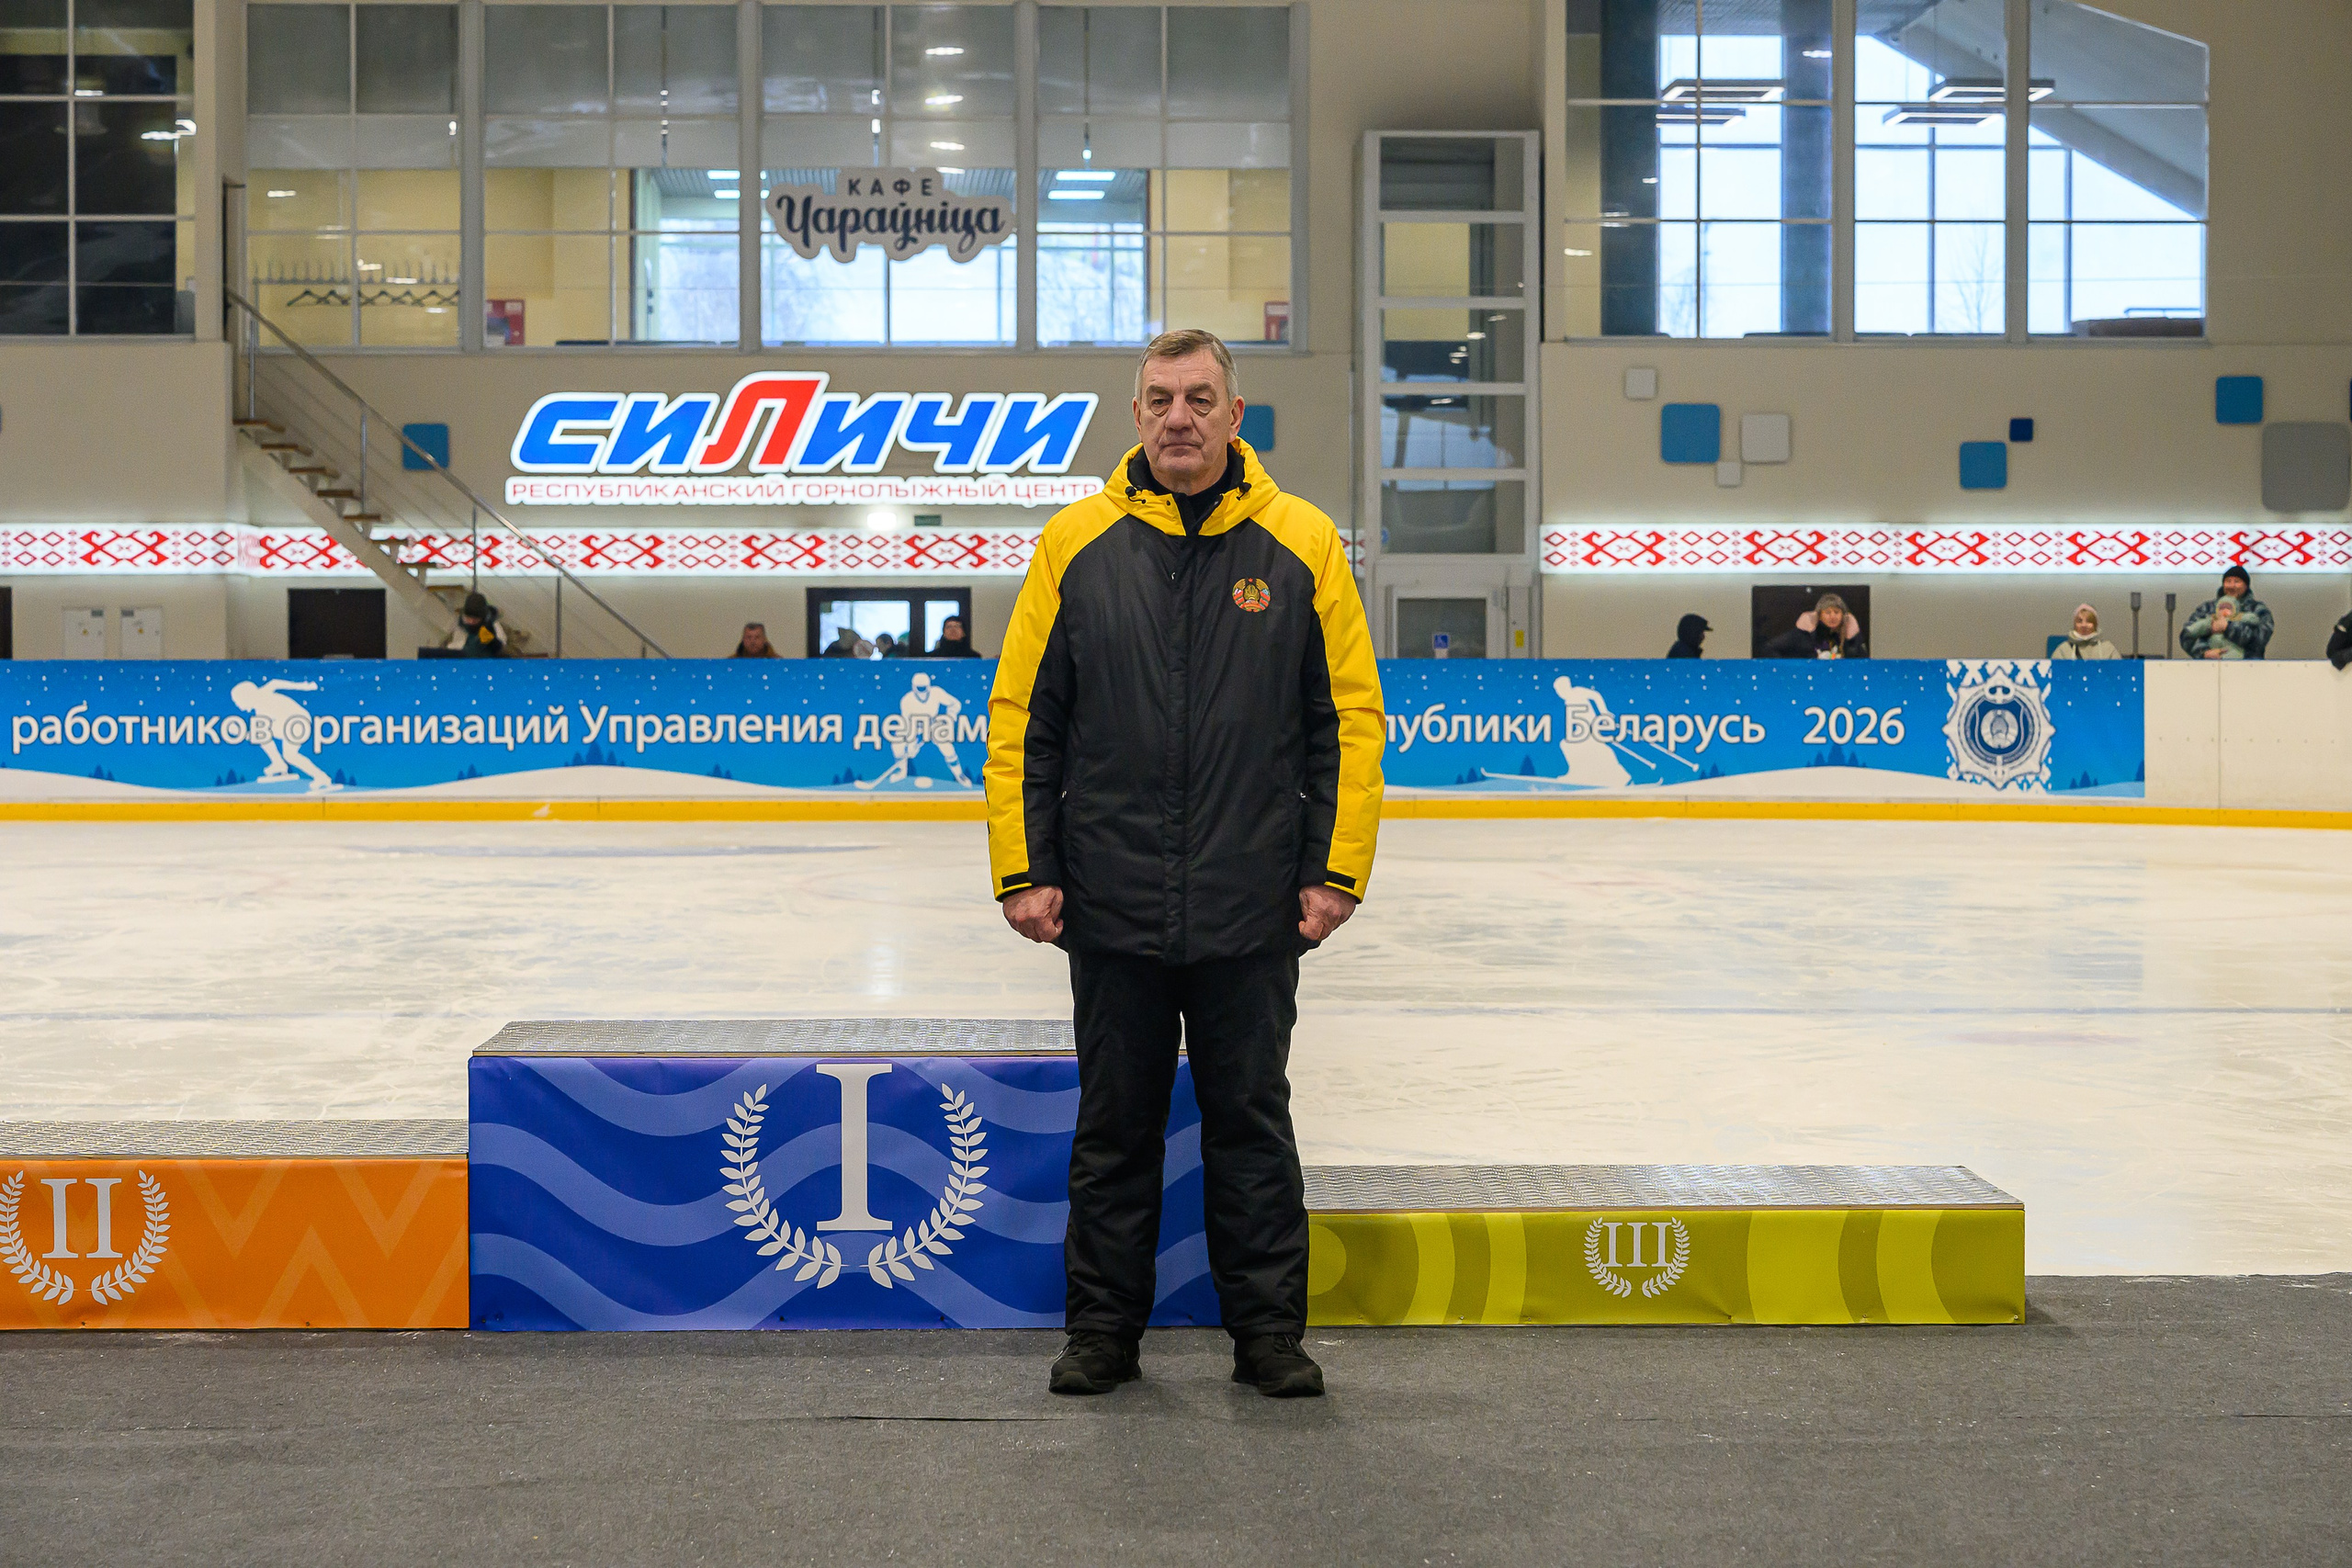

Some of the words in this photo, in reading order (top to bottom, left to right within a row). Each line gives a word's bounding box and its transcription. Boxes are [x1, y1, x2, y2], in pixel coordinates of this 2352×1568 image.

[847, 177, 933, 197] КАФЕ
[512, 479, 785, 498] РЕСПУБЛИКАНСКИЙ
[791, 479, 1007, 498] ГОРНОЛЫЖНЫЙ
[1014, 483, 1098, 500] ЦЕНТР
[11, 704, 273, 753] работников
[283, 705, 570, 752] организаций
[580, 705, 842, 753] Управления
[1565, 704, 1766, 752] Беларусь
[1803, 705, 1905, 746] 2026
[816, 1063, 893, 1231] I
[40, 1178, 123, 1258] II
[1602, 1222, 1672, 1268] III
